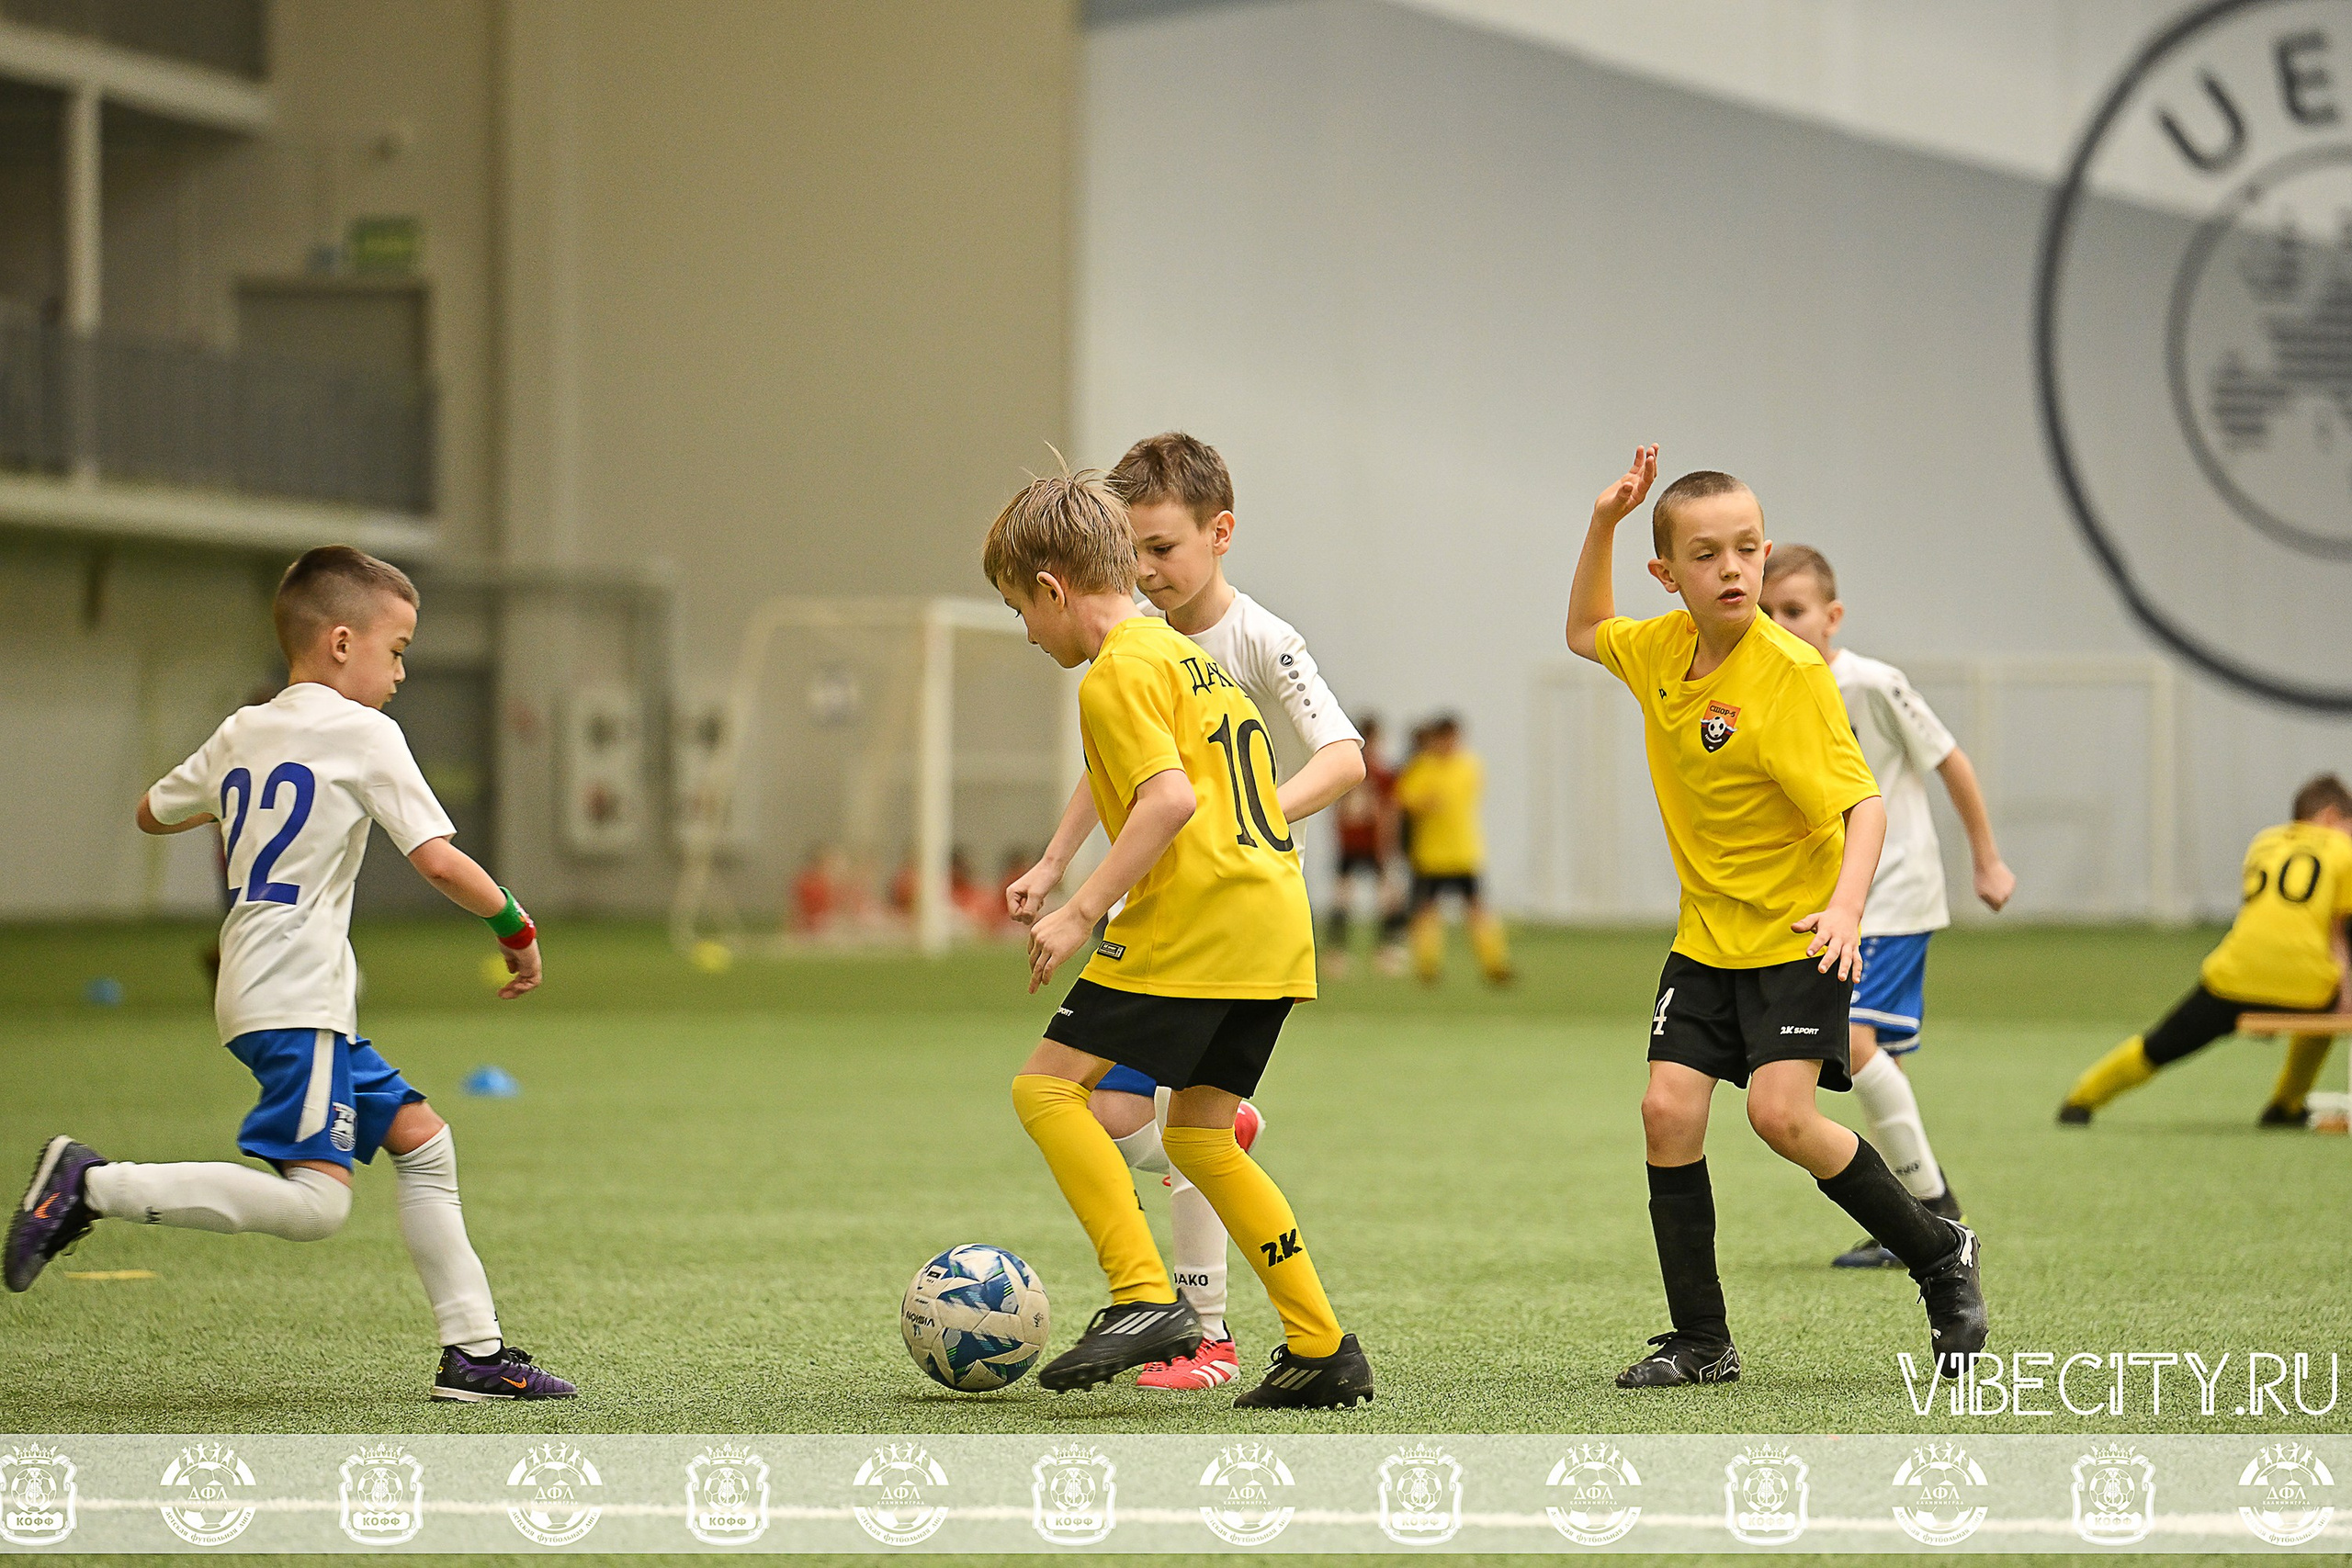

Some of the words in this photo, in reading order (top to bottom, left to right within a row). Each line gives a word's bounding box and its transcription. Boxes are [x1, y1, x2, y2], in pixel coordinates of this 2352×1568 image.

[1207, 714, 1295, 852] 10
[220, 761, 315, 905] 22
[1653, 987, 1675, 1035] 4
[1793, 1027, 1819, 1035] SPORT
